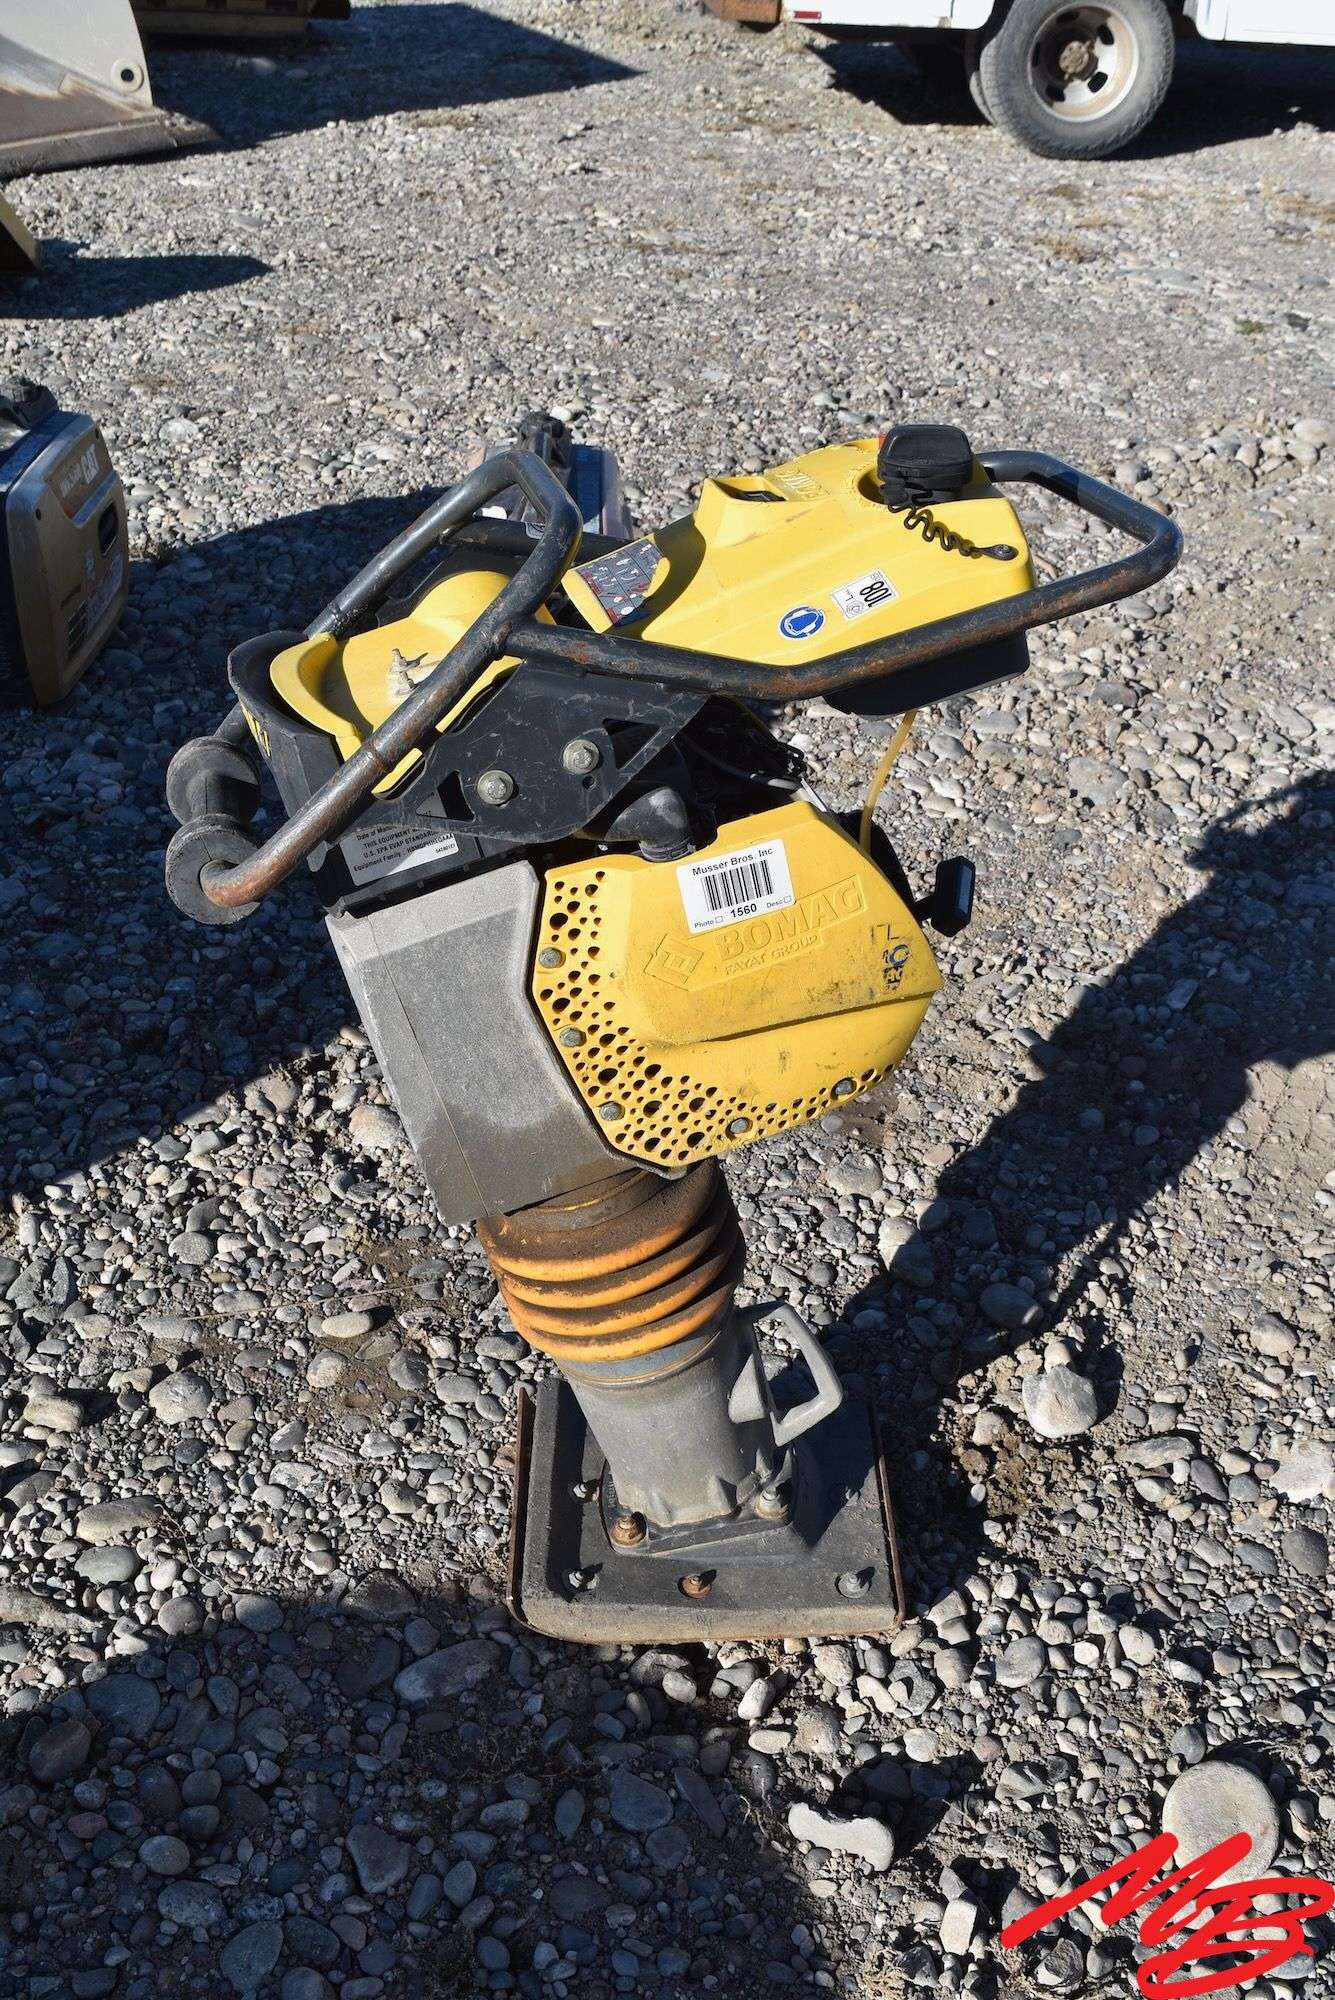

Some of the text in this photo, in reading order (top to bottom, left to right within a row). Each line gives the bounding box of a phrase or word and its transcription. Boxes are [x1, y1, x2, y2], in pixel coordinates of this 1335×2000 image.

[860, 581, 892, 607] 108
[364, 841, 377, 849] THIS
[378, 829, 411, 845] EQUIPMENT
[363, 850, 375, 859] U.S.
[376, 845, 388, 855] EPA
[389, 840, 404, 850] EVAP
[353, 859, 383, 872] Equipment
[383, 852, 401, 863] Family
[692, 847, 773, 876] Musser Bros. Inc
[730, 903, 757, 918] 1560
[767, 900, 783, 909] Desc
[694, 920, 714, 929] Photo
[717, 880, 862, 961] BOMAG
[724, 934, 818, 975] FAYAT GROUP
